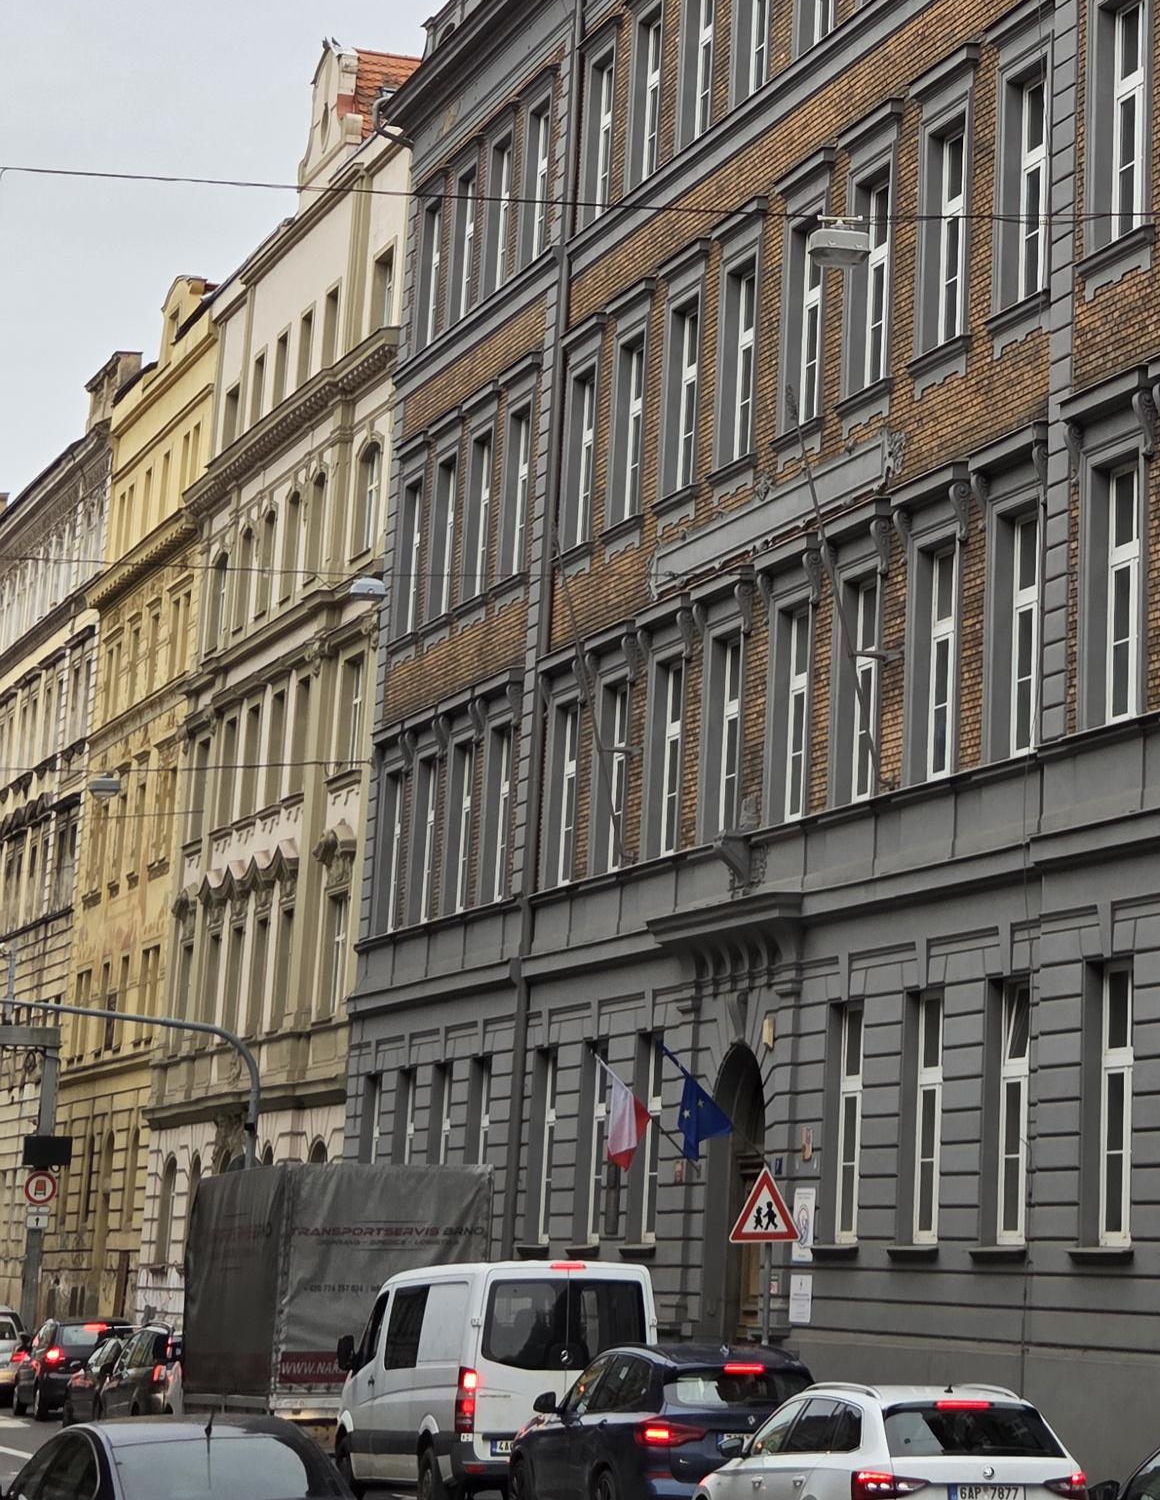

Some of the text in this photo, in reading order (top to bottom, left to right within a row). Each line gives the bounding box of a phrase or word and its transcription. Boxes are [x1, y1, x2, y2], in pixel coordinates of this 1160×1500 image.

[442, 1226, 485, 1236] BRNO
[960, 1486, 1019, 1500] 6AP 7877
